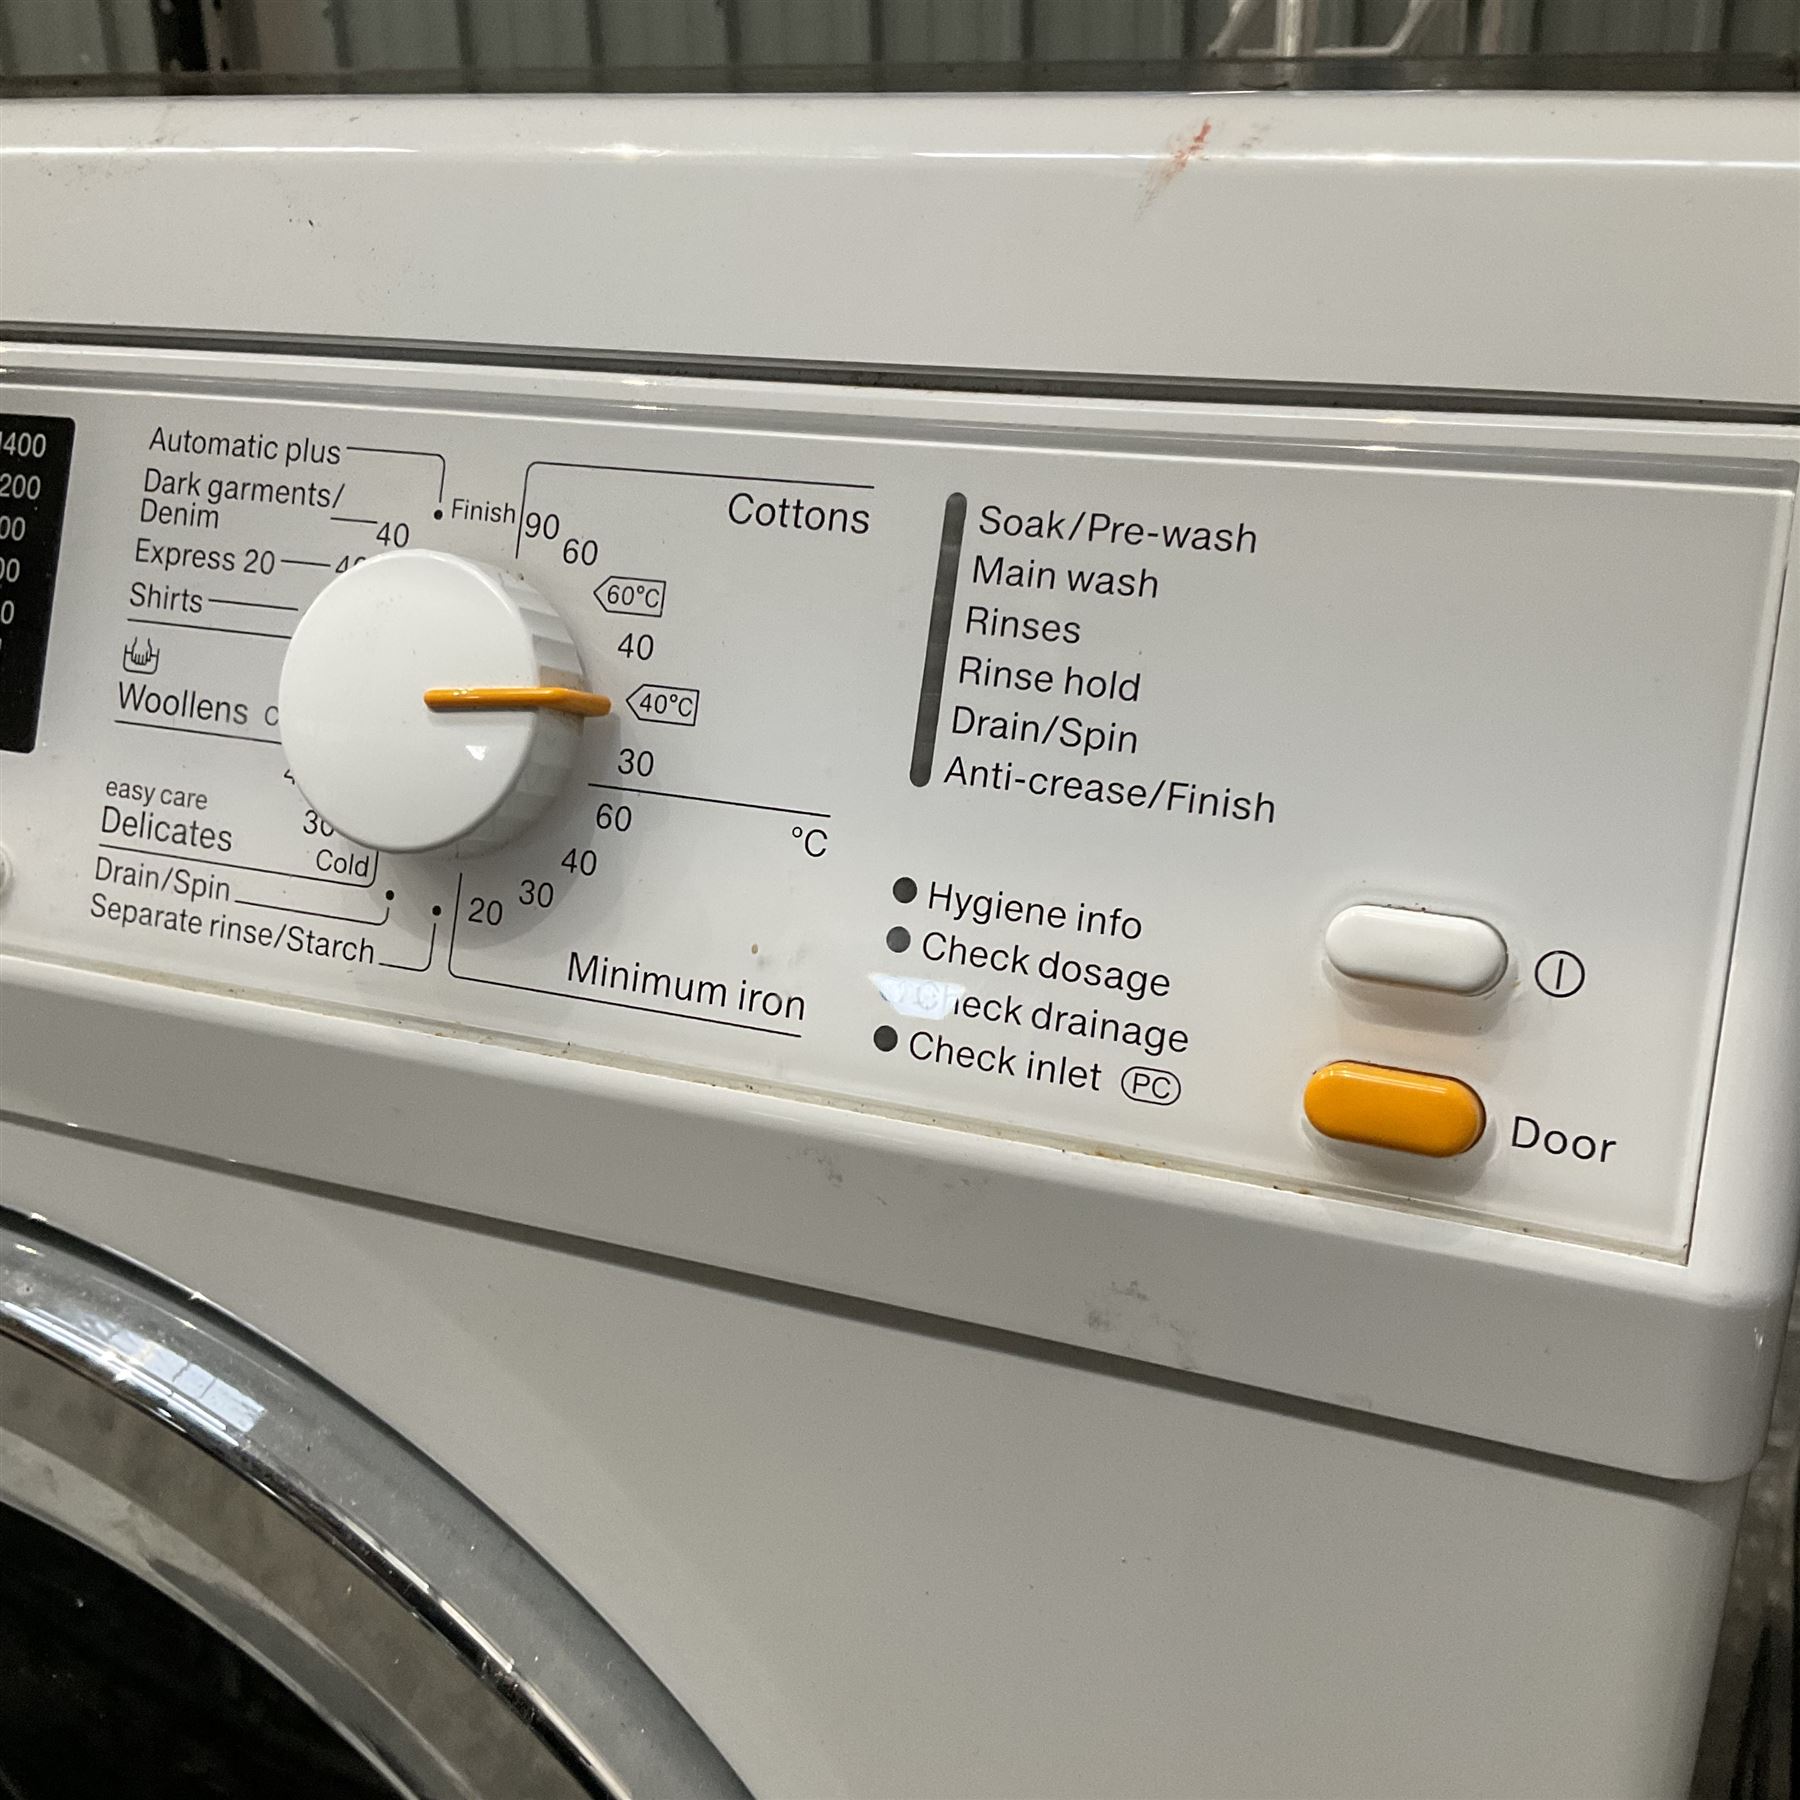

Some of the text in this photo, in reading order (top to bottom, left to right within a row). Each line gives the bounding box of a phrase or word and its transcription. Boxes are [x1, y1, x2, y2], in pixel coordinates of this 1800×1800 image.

[149, 427, 341, 467] Automatic plus
[144, 468, 346, 509] Dark garments/
[140, 498, 220, 529] Denim
[451, 499, 517, 525] Finish
[525, 511, 560, 541] 90
[728, 492, 871, 535] Cottons
[978, 505, 1258, 553] Soak/Pre-wash
[376, 522, 410, 548] 40
[562, 538, 598, 567] 60
[135, 538, 275, 575] Express 20
[972, 555, 1159, 598] Main wash
[130, 582, 203, 613] Shirts
[607, 585, 660, 609] 60°C
[965, 605, 1082, 645] Rinses
[617, 633, 655, 661] 40
[958, 655, 1141, 702] Rinse hold
[118, 681, 248, 726] Woollens
[639, 693, 694, 718] 40°C
[952, 705, 1138, 756] Drain/Spin
[617, 748, 655, 777] 30
[105, 780, 209, 811] easy care
[943, 755, 1276, 824] Anti-crease/Finish
[101, 805, 233, 852] Delicates
[596, 803, 632, 832] 60
[791, 826, 829, 858] °C
[95, 856, 231, 902] Drain/Spin
[315, 849, 369, 878] Cold
[561, 848, 598, 877] 40
[468, 897, 503, 926] 20
[518, 879, 554, 908] 30
[928, 881, 1143, 940] Hygiene info
[90, 893, 375, 964] Separate rinse/Starch
[568, 951, 806, 1021] Minimum iron
[922, 931, 1171, 1001] Check dosage
[1031, 1001, 1189, 1056] drainage
[909, 1031, 1172, 1100] Check inlet PC
[1511, 1115, 1617, 1163] Door
